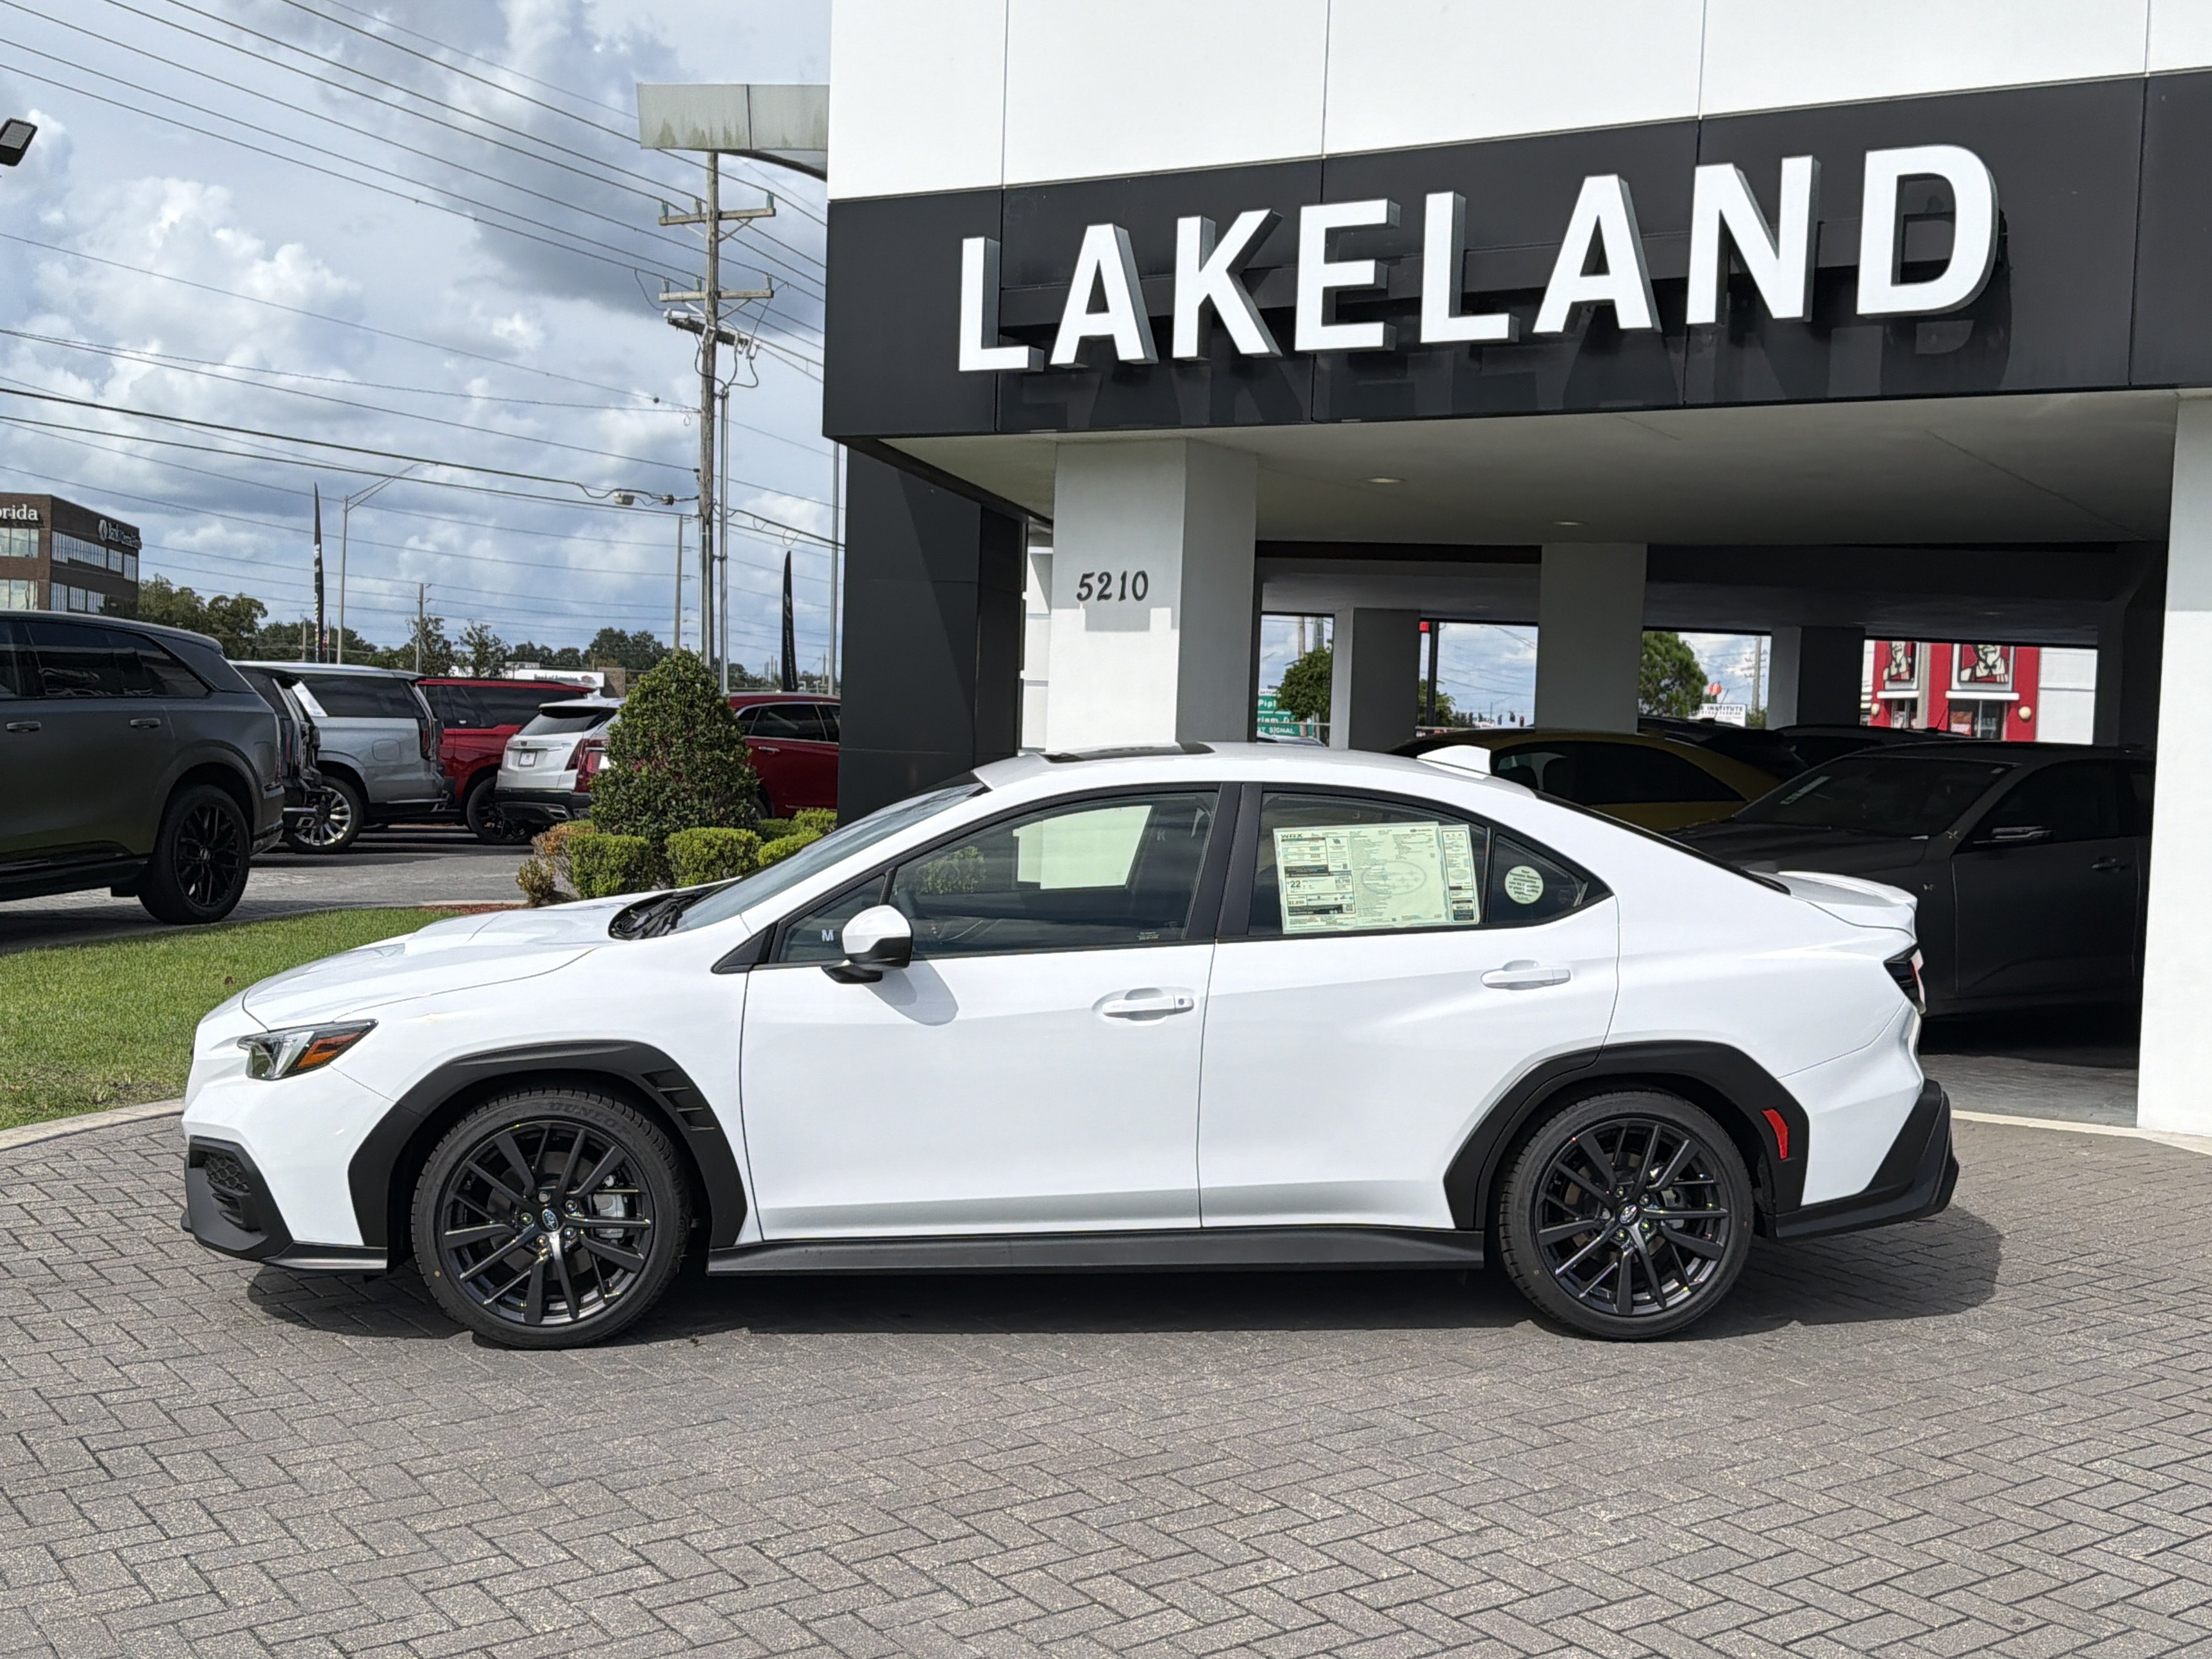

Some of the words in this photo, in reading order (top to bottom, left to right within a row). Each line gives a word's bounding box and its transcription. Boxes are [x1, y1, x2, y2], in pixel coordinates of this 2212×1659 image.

[959, 144, 1998, 372] LAKELAND
[1076, 570, 1149, 602] 5210
[821, 929, 834, 942] M
